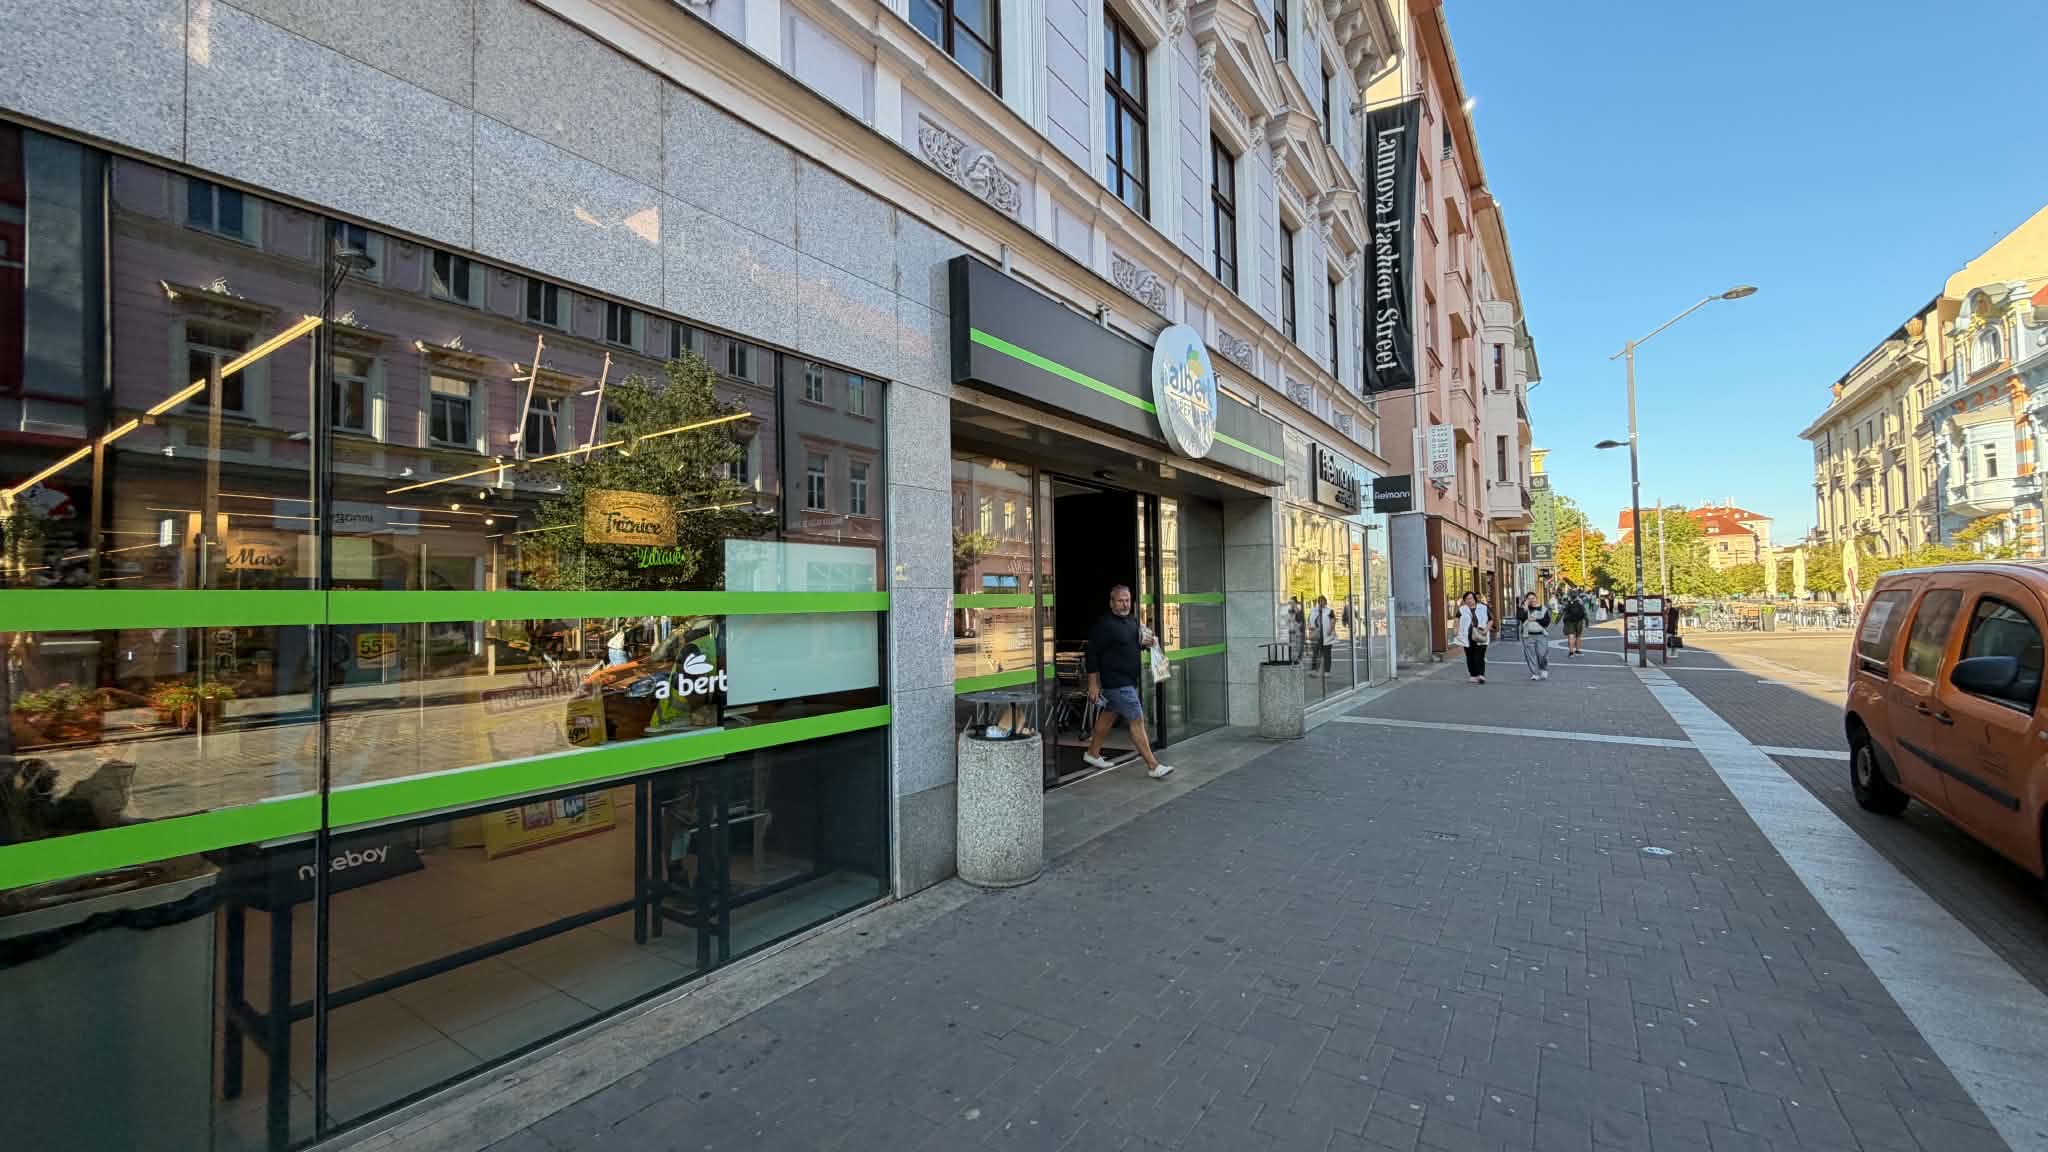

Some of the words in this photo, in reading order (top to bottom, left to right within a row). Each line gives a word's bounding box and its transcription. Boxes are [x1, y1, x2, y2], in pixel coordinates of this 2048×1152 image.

[1376, 126, 1405, 215] Lannova
[1376, 219, 1400, 301] Fashion
[1376, 308, 1399, 371] Street
[298, 844, 388, 880] neboy
